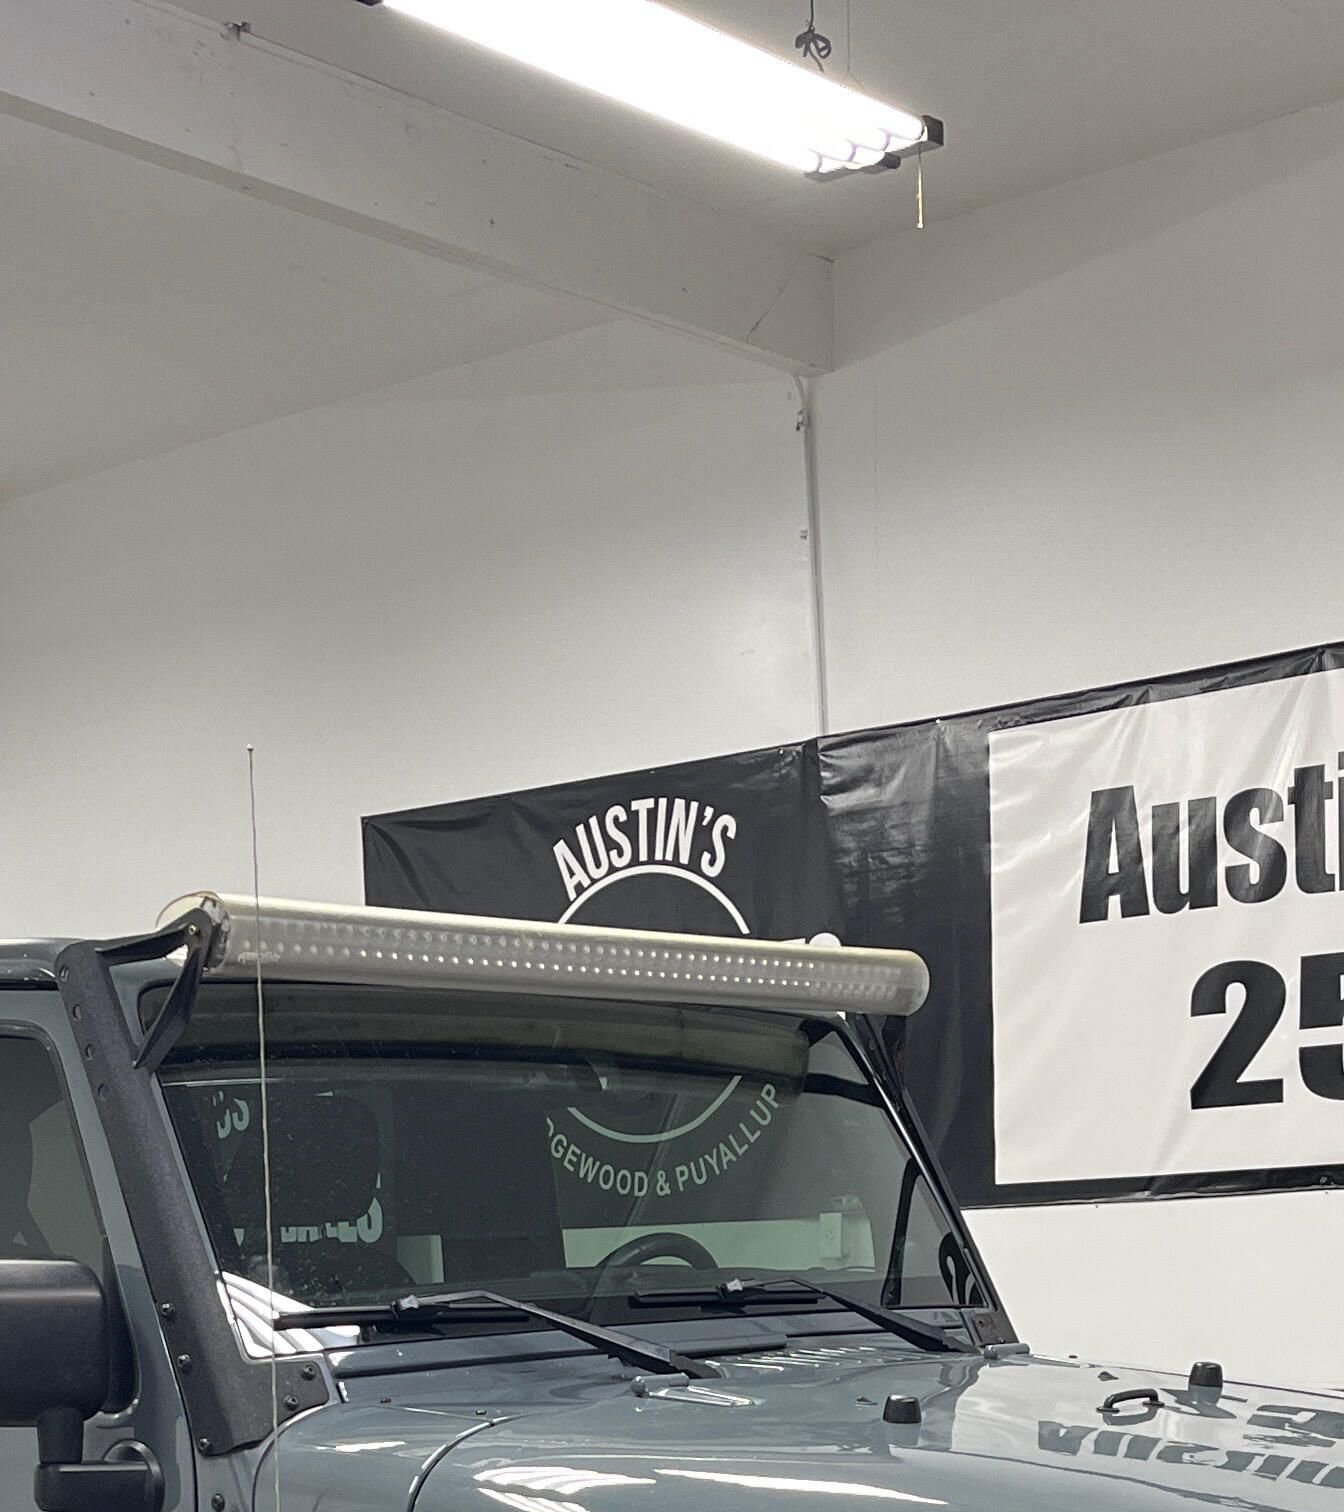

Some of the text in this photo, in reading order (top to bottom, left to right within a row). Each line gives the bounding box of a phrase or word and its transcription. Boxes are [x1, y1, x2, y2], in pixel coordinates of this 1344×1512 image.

[553, 797, 737, 902] AUSTIN'S
[656, 1170, 672, 1198] &
[675, 1083, 781, 1192] PUYALLUP
